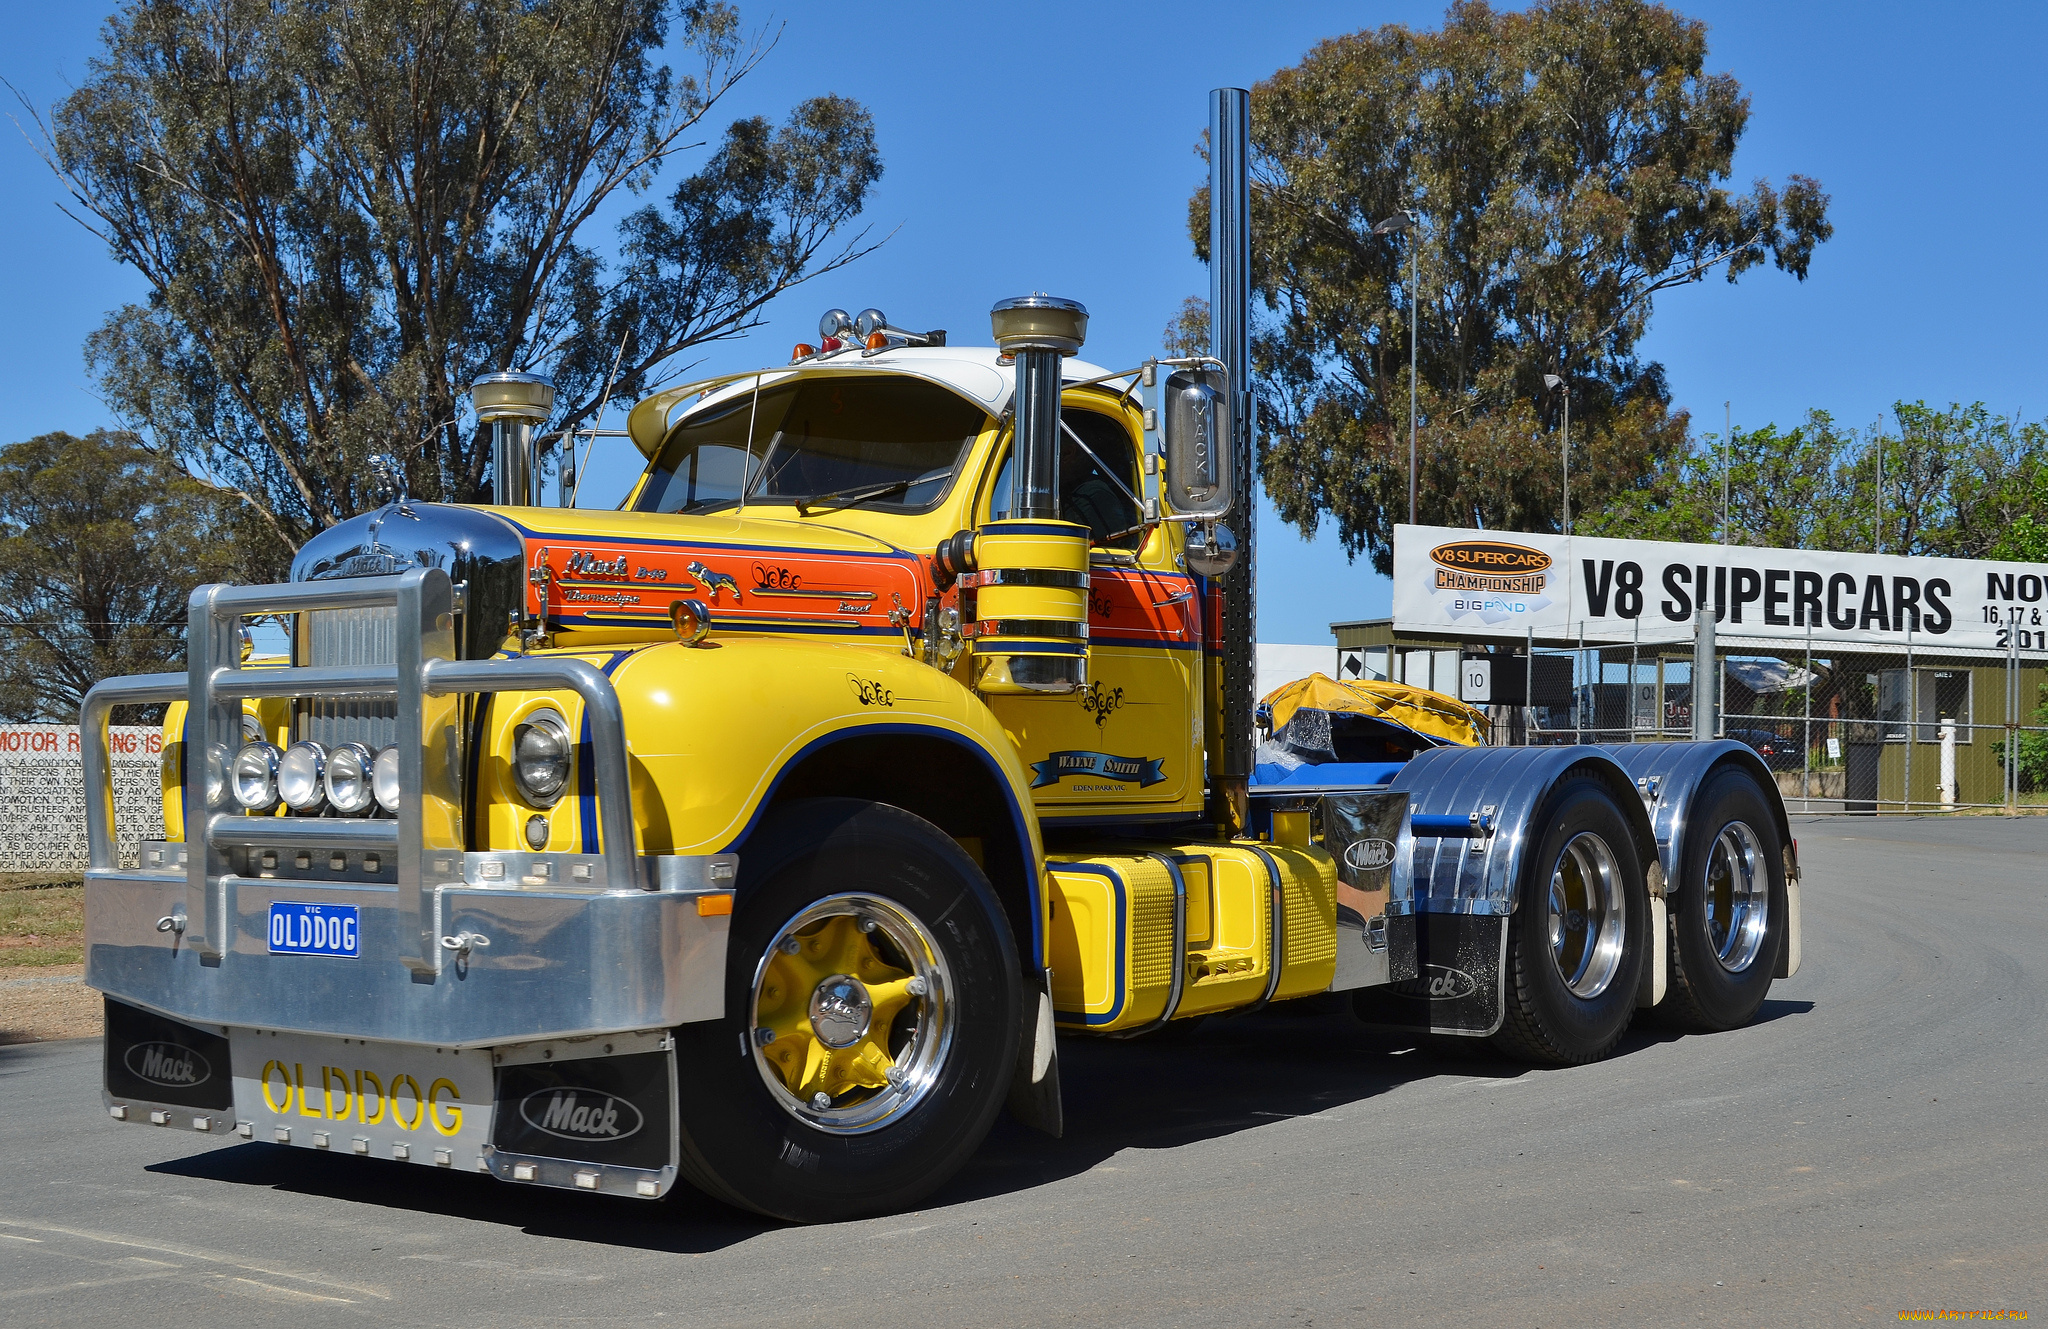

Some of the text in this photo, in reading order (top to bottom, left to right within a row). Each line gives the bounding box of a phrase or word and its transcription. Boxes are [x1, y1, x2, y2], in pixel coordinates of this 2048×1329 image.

[562, 550, 628, 576] Mack
[1434, 550, 1549, 567] V8 SUPERCARS
[1436, 570, 1544, 593] CHAMPIONSHIP
[1987, 572, 2048, 603] NO
[564, 590, 640, 608] Thermodyne
[1582, 559, 1952, 635] V8 SUPERCARS
[1982, 605, 2041, 628] 16, 17 &
[1996, 629, 2046, 649] 201
[1469, 673, 1483, 688] 10
[0, 732, 58, 751] MOTOR
[16, 768, 59, 776] PERSONS
[112, 760, 157, 768] DMISSION
[1058, 756, 1140, 774] WAYNE SMITH
[0, 796, 50, 804] ROMOTION
[56, 796, 70, 804] OR
[1356, 842, 1389, 867] Mack
[305, 906, 321, 914] VIC
[272, 913, 356, 951] OLDDOG
[141, 1044, 196, 1083] Mack
[261, 1059, 463, 1137] OLDDOG
[542, 1091, 620, 1136] Mack
